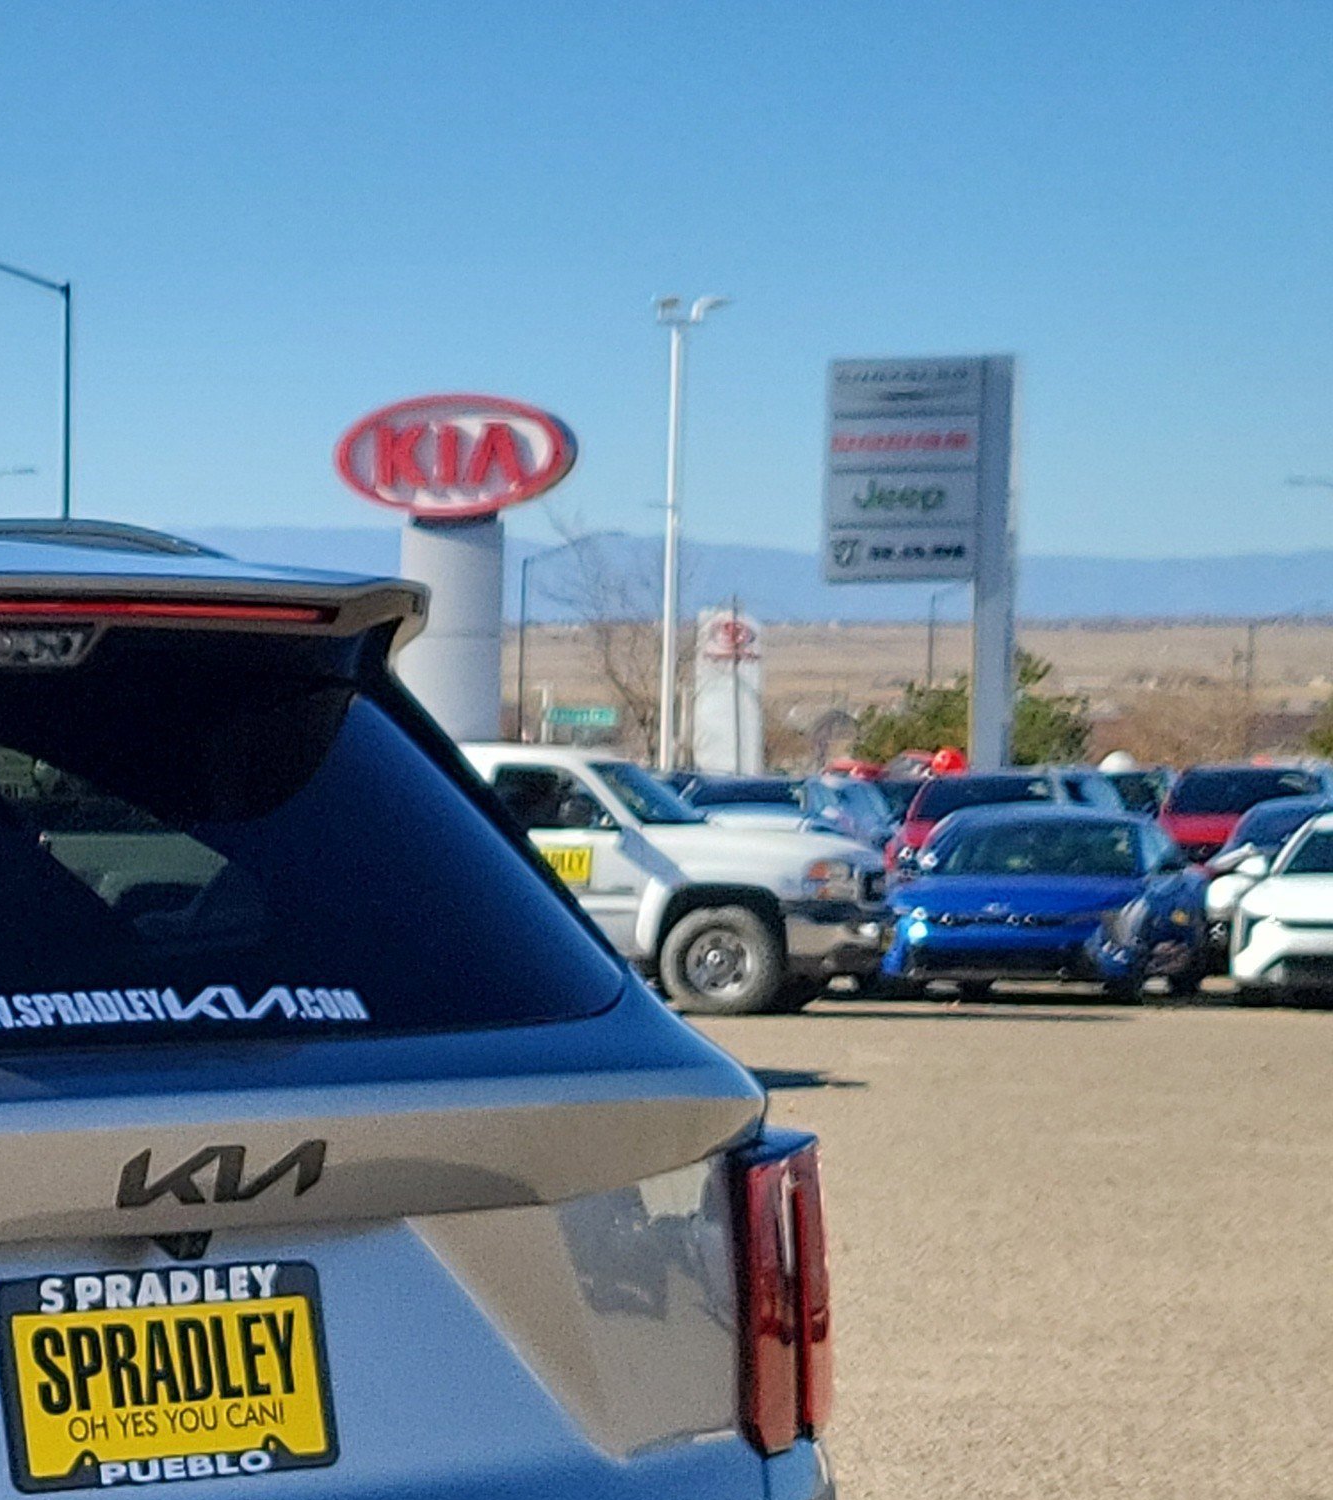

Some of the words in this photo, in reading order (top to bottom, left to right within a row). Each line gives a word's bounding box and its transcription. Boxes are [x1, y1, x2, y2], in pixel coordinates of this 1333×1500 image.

[374, 421, 527, 487] KIA
[115, 1139, 327, 1209] KIA
[39, 1263, 279, 1314] SPRADLEY
[32, 1309, 296, 1416] SPRADLEY
[68, 1414, 109, 1443] OH
[117, 1409, 158, 1438] YES
[165, 1405, 219, 1434] YOU
[99, 1448, 273, 1486] PUEBLO
